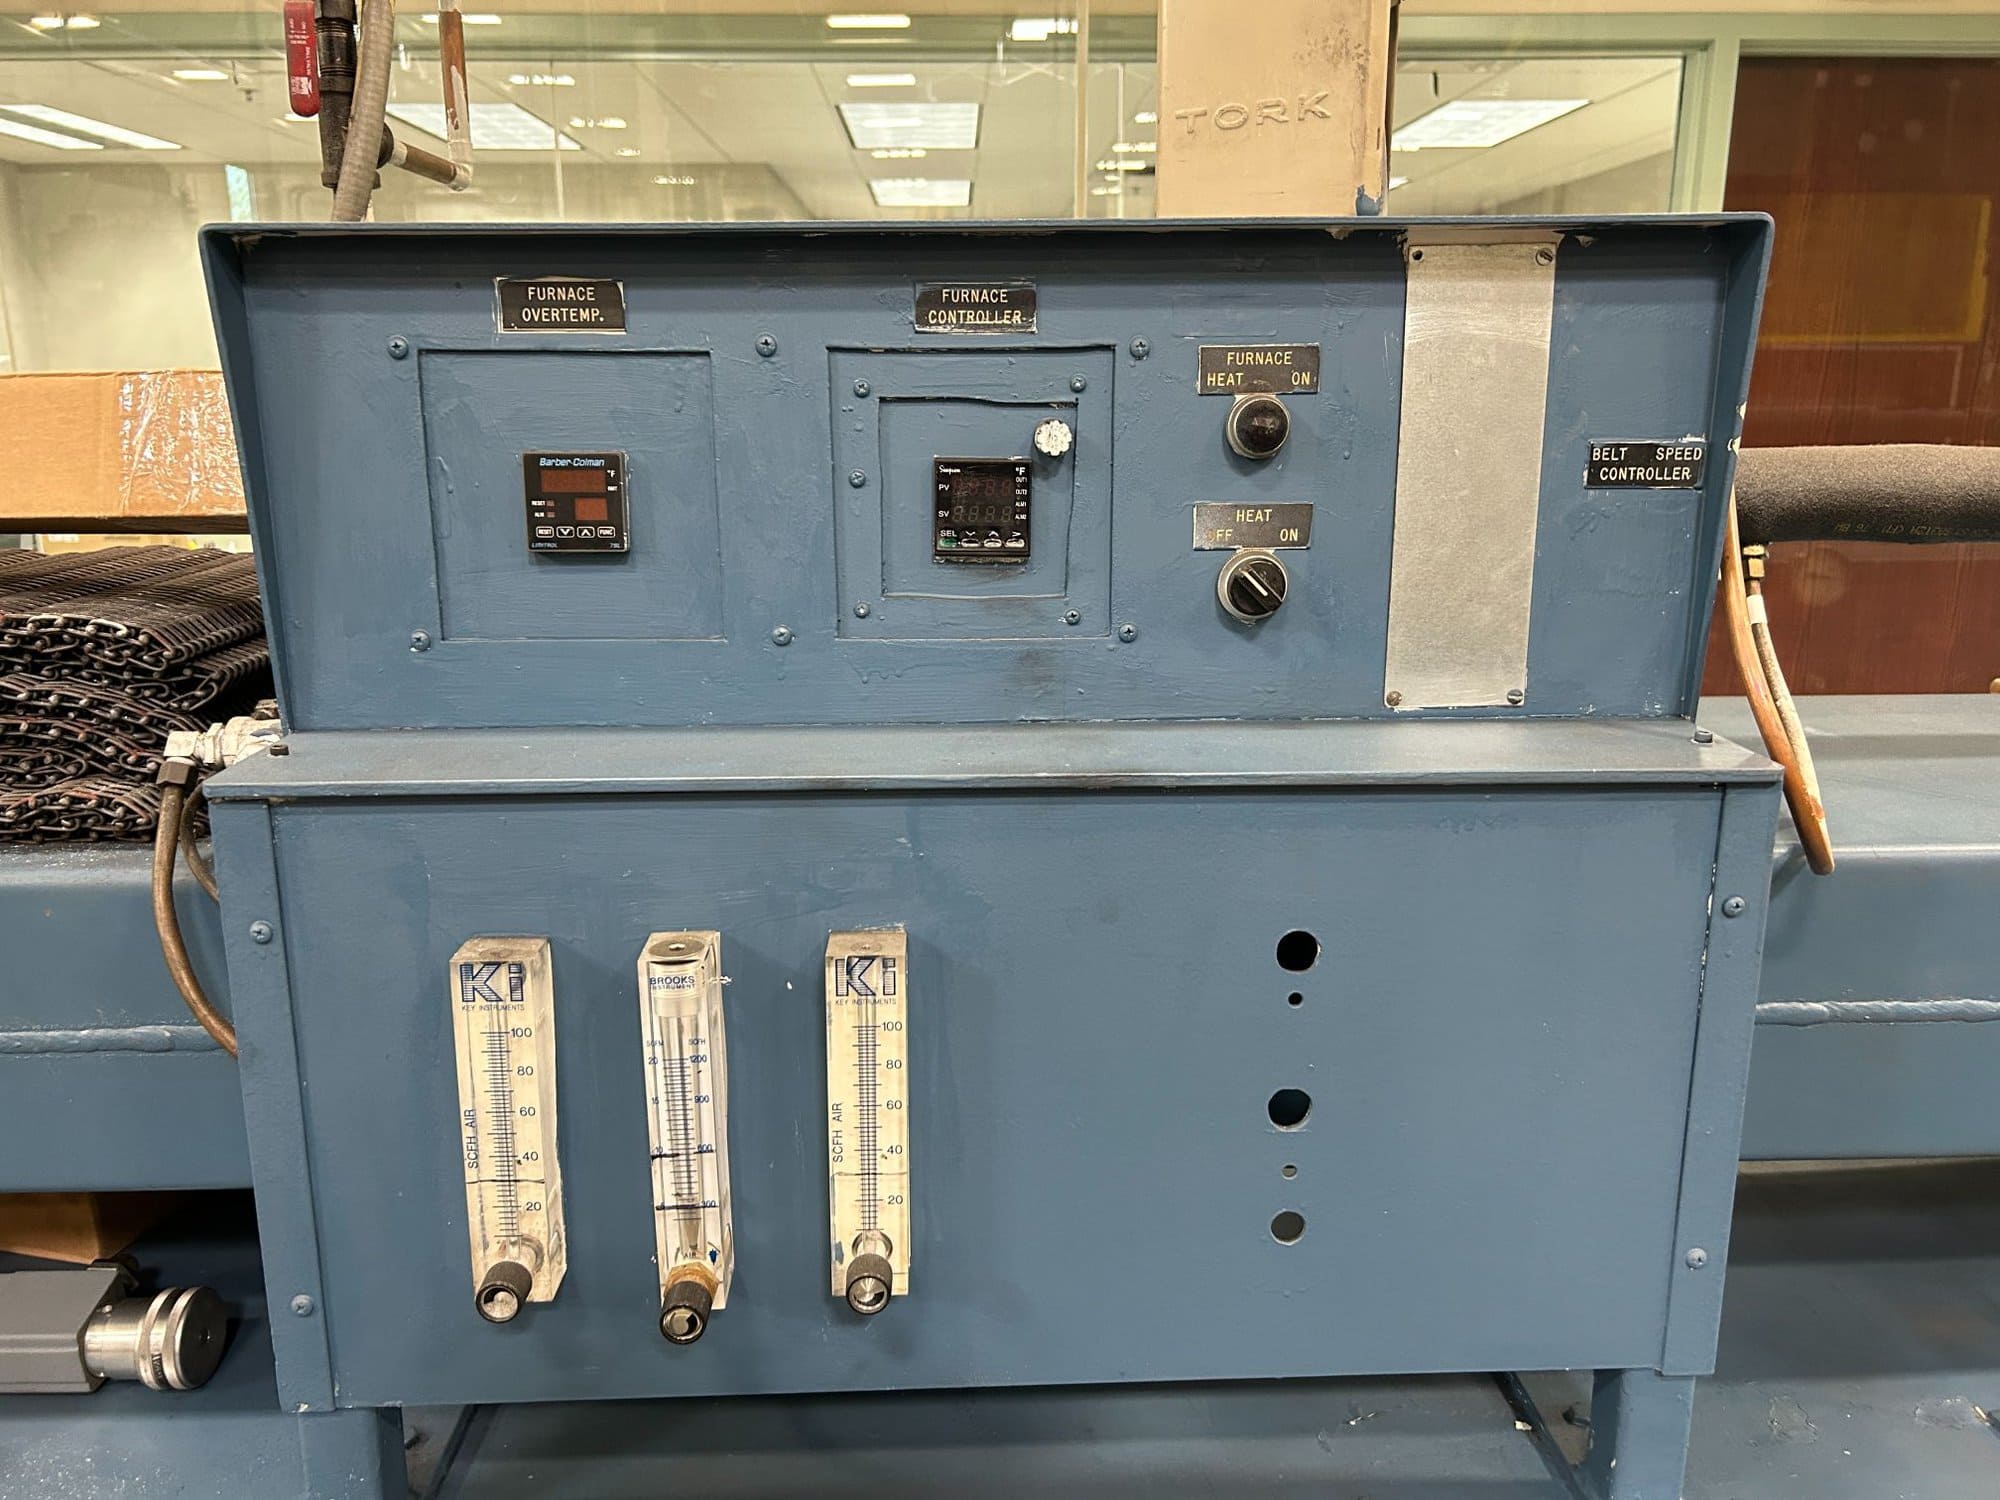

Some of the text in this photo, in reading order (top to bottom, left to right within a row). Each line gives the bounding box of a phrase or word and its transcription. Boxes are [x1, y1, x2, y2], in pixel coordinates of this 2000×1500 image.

[1175, 90, 1332, 134] TORK
[528, 286, 596, 301] FURNACE
[942, 289, 1008, 303] FURNACE
[522, 307, 605, 322] OVERTEMP.
[928, 310, 1022, 324] CONTROLLER
[1227, 351, 1292, 366] FURNACE
[1207, 372, 1310, 387] HEAT ON
[1593, 447, 1703, 461] BELT SPEED
[539, 458, 605, 467] Barber-Colman
[1600, 467, 1691, 481] CONTROLLER
[1236, 509, 1272, 522] HEAT
[1280, 528, 1298, 542] ON
[460, 963, 524, 1002] Ki
[650, 976, 695, 985] BROOKS
[835, 957, 896, 996] Ki
[511, 1028, 532, 1038] 100
[882, 1022, 902, 1031] 100
[517, 1066, 534, 1076] 80
[886, 1059, 902, 1069] 80
[520, 1107, 536, 1116] 60
[886, 1100, 902, 1110] 60
[464, 1109, 476, 1127] AIR
[832, 1103, 843, 1163] SCFH AIR
[522, 1152, 538, 1161] 40
[887, 1145, 902, 1154] 40
[526, 1202, 542, 1211] 20
[888, 1196, 903, 1205] 20
